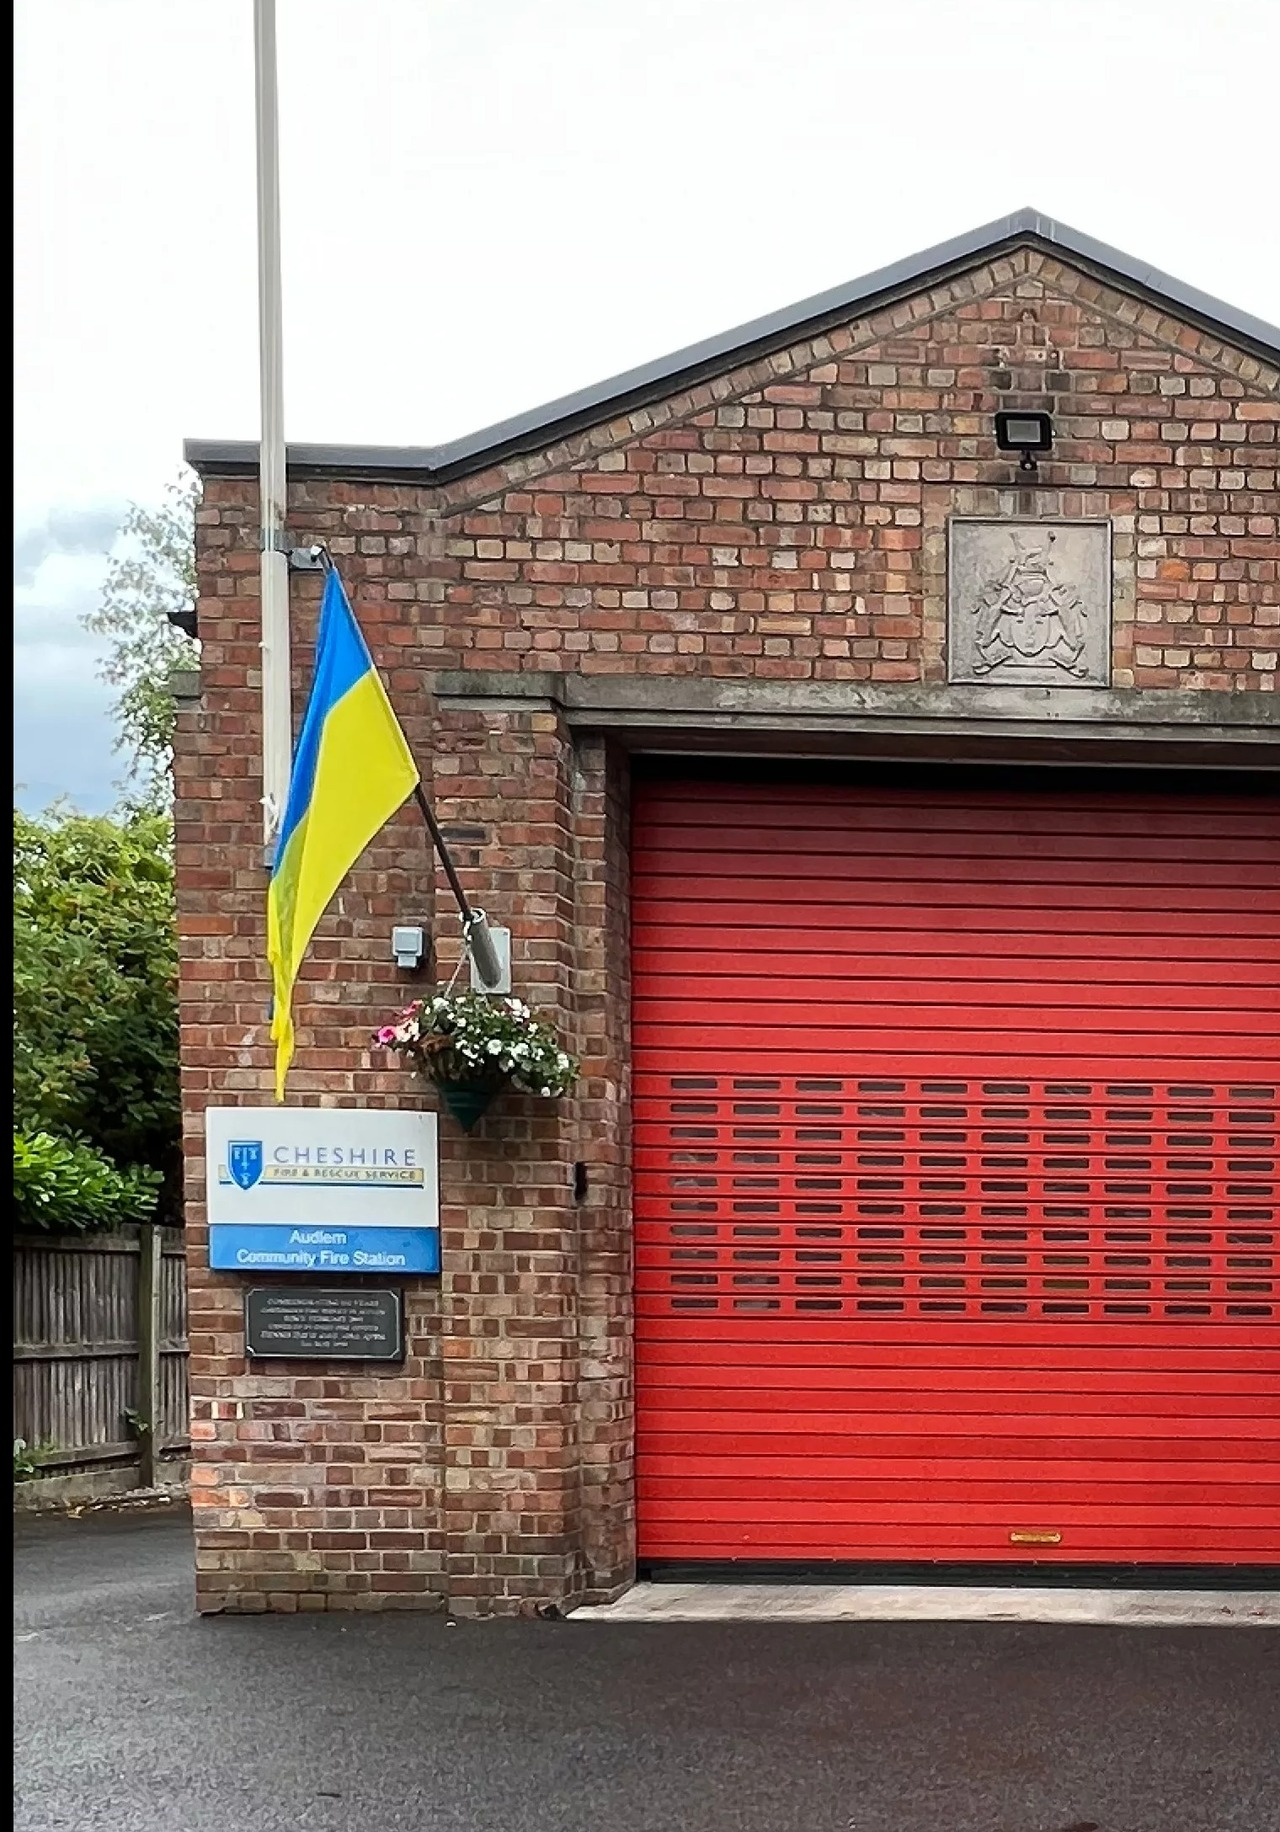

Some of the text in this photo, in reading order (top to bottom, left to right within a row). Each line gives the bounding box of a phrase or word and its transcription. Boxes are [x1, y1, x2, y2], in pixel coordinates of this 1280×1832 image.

[273, 1146, 416, 1167] CHESHIRE
[273, 1168, 416, 1181] FIRE & RESCUE SERVICE
[290, 1230, 347, 1245] Audlem
[236, 1249, 406, 1267] Community Fire Station
